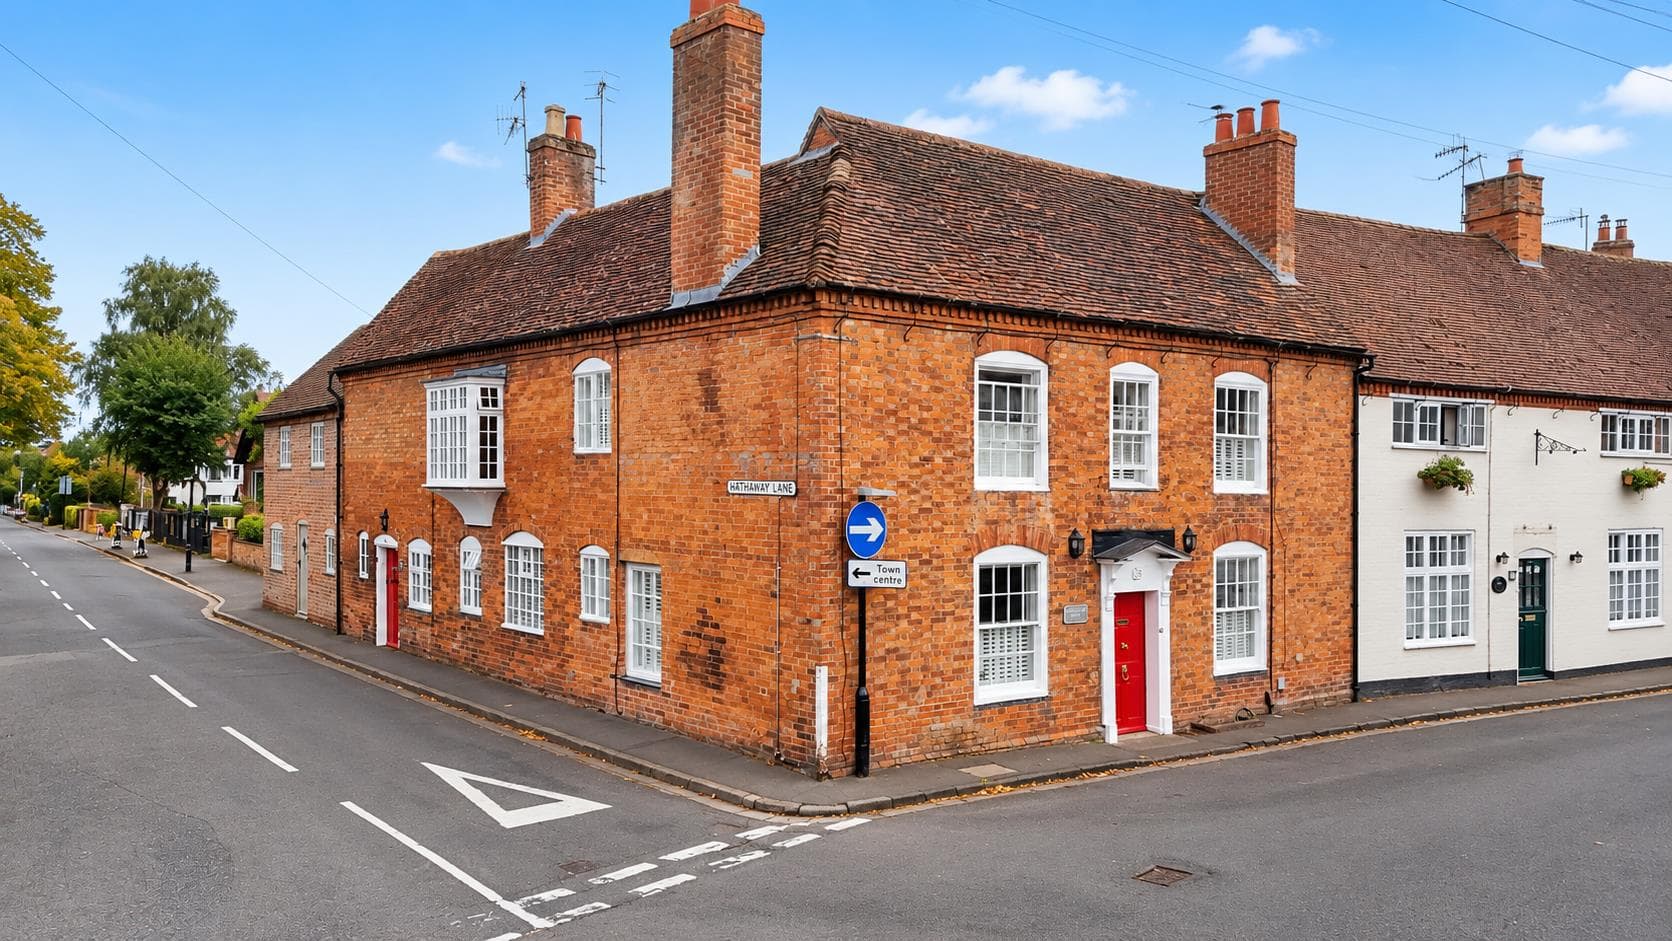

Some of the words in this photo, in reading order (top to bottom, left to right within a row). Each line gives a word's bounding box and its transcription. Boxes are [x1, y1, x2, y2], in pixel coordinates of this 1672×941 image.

[730, 481, 769, 493] HATHAWAY
[773, 483, 793, 493] LANE
[877, 564, 900, 574] Town
[873, 576, 902, 585] centre
